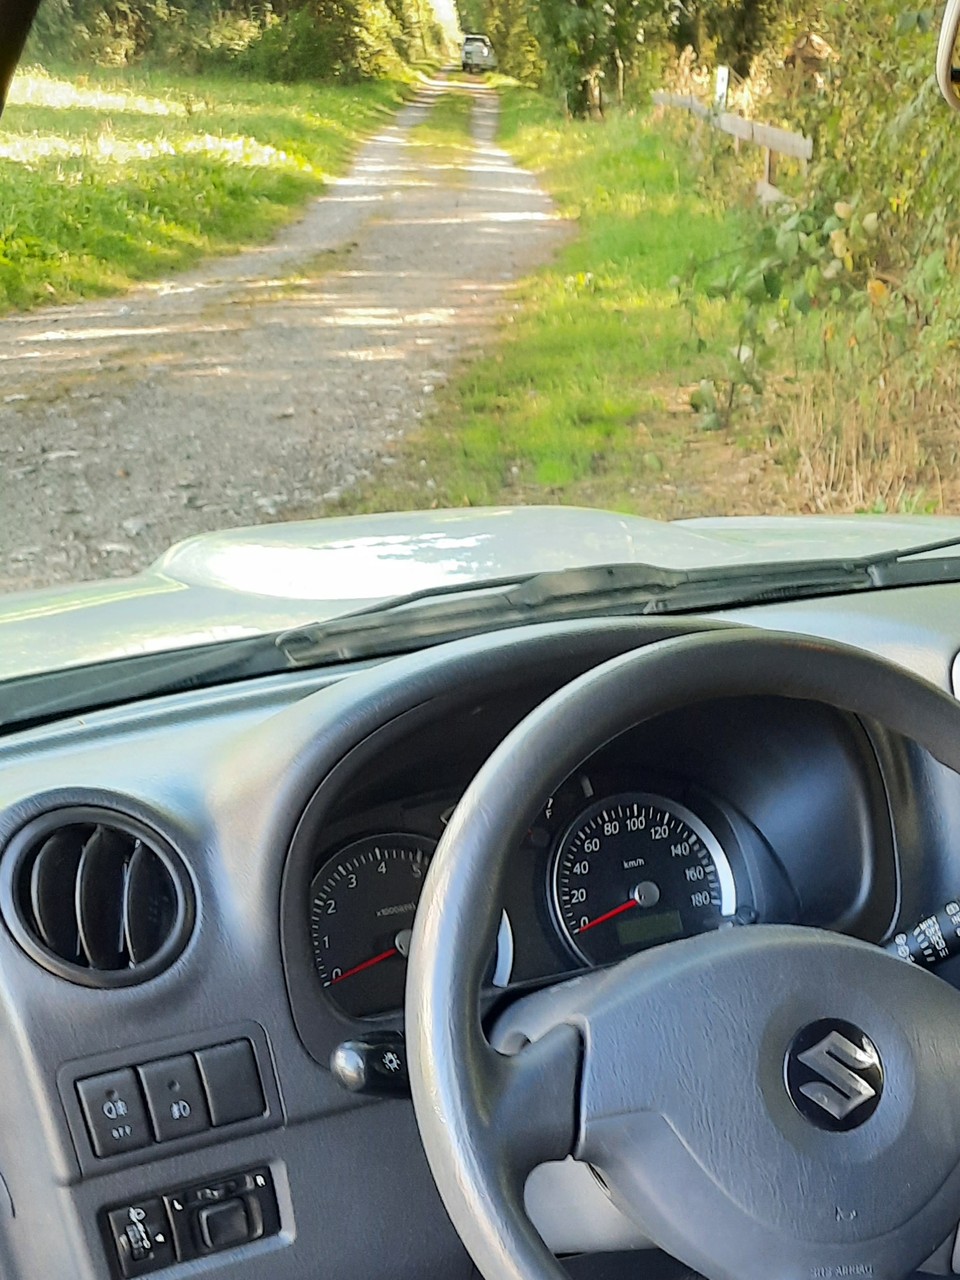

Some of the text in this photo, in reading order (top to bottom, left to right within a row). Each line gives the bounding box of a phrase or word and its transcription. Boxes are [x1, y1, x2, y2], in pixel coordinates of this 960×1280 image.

[603, 821, 620, 837] 80
[626, 815, 646, 832] 100
[650, 824, 669, 841] 120
[584, 837, 600, 853] 60
[670, 841, 690, 858] 140
[377, 861, 387, 875] 4
[412, 864, 423, 879] 5
[572, 860, 589, 876] 40
[623, 857, 645, 870] km/h
[347, 874, 358, 889] 3
[684, 865, 704, 882] 160
[571, 888, 587, 904] 20
[690, 890, 710, 908] 180
[326, 900, 337, 914] 2
[323, 936, 330, 949] 1
